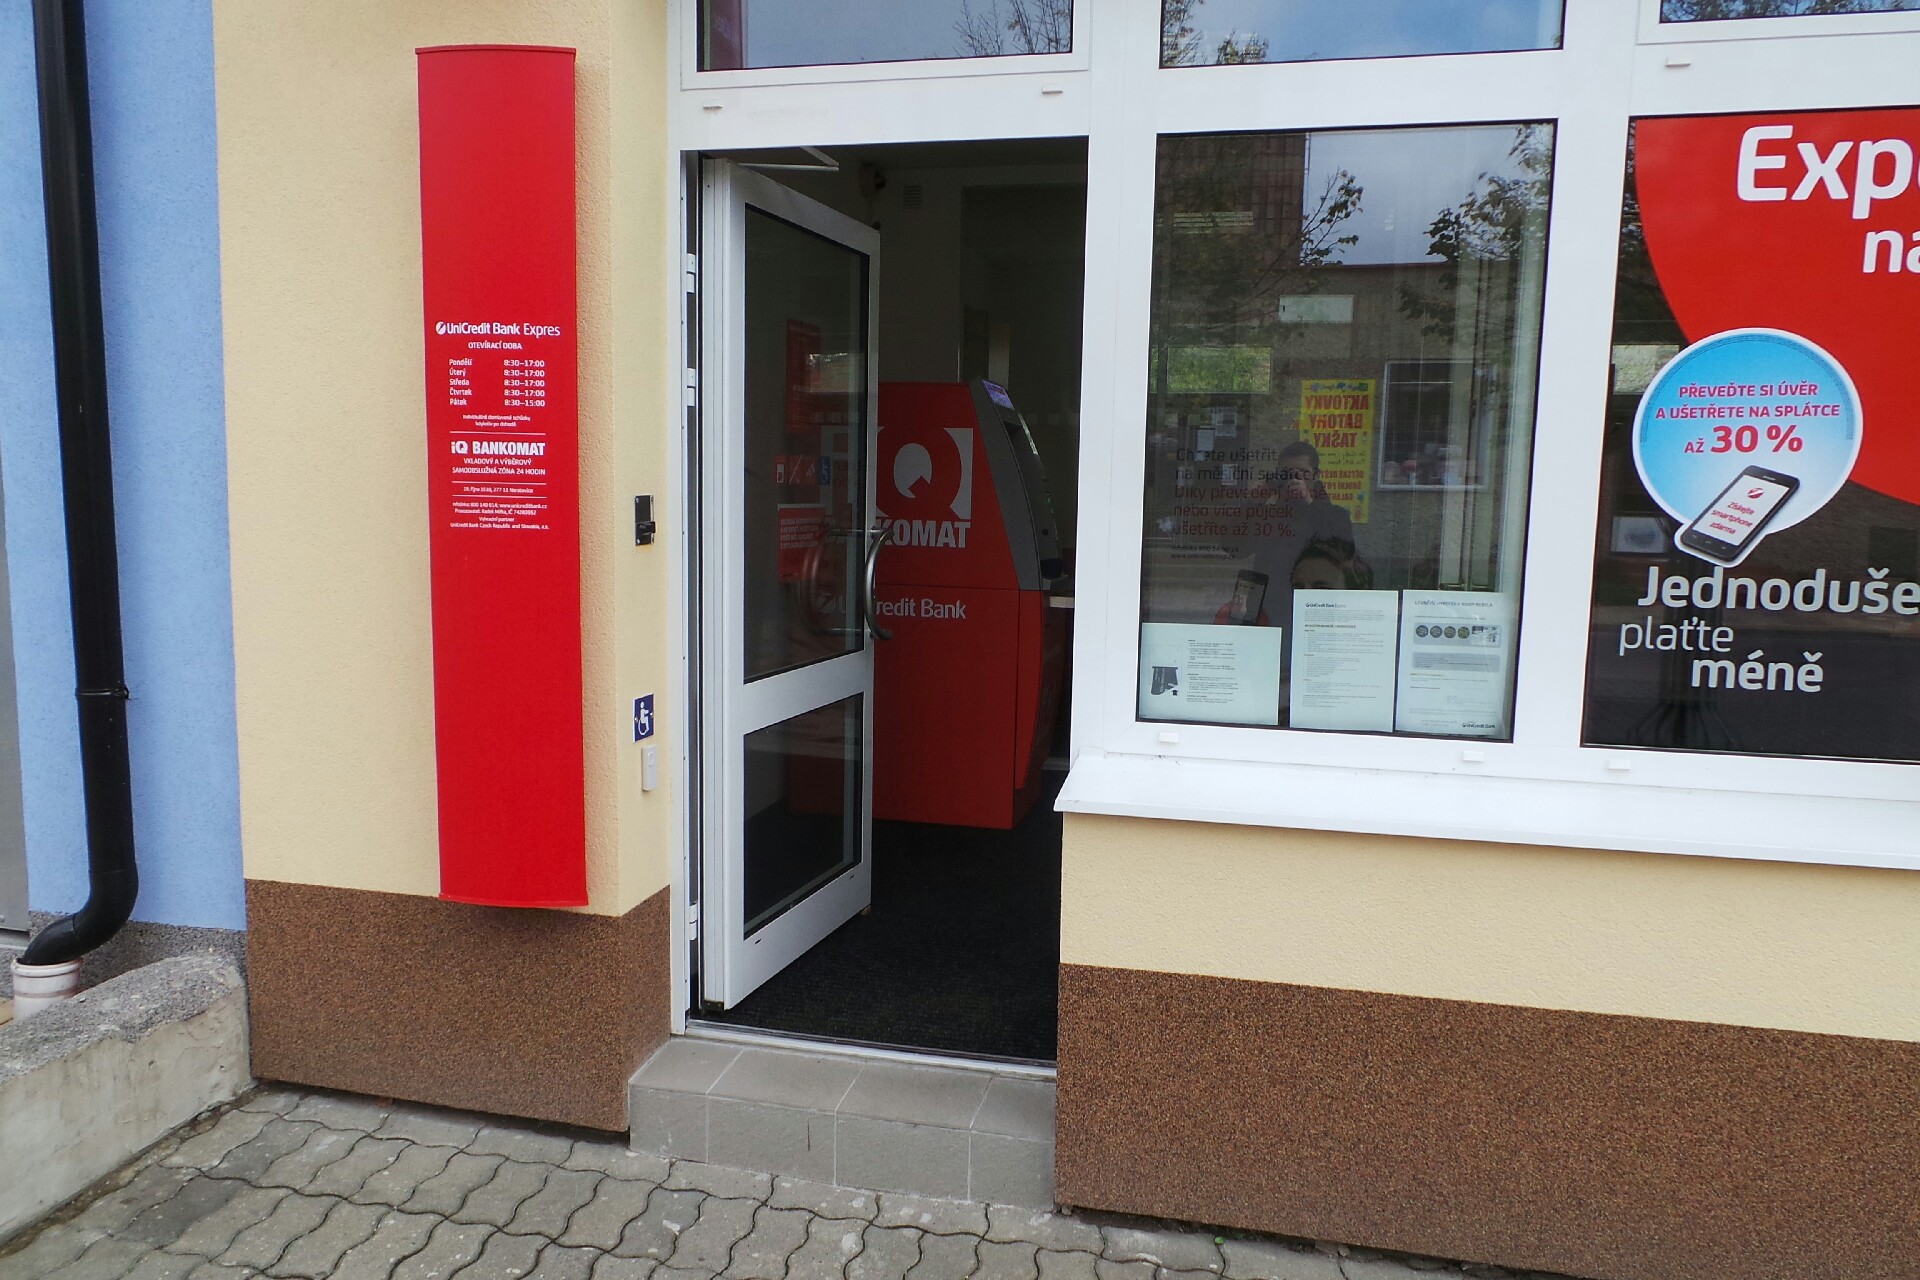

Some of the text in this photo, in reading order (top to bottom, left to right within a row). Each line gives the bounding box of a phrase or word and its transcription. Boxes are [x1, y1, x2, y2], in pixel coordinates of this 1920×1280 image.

[1736, 124, 1920, 220] Exp
[447, 322, 560, 338] UniCredit Bank Expres
[468, 340, 522, 350] OTEVÍRACÍ DOBA
[1678, 380, 1818, 398] PŘEVEĎTE SI ÚVĚR
[1655, 401, 1840, 419] A UŠETŘETE NA SPLÁTCE
[1684, 424, 1803, 454] AŽ 30 %
[472, 441, 545, 456] BANKOMAT
[1711, 509, 1753, 528] smartphone
[1232, 523, 1248, 536] až
[1254, 523, 1273, 536] 30
[1709, 522, 1737, 535] zdarma
[1636, 565, 1920, 615] Jednoduše
[876, 597, 967, 620] redit Bank
[1618, 615, 1734, 656] plaťte
[1691, 649, 1824, 693] méně
